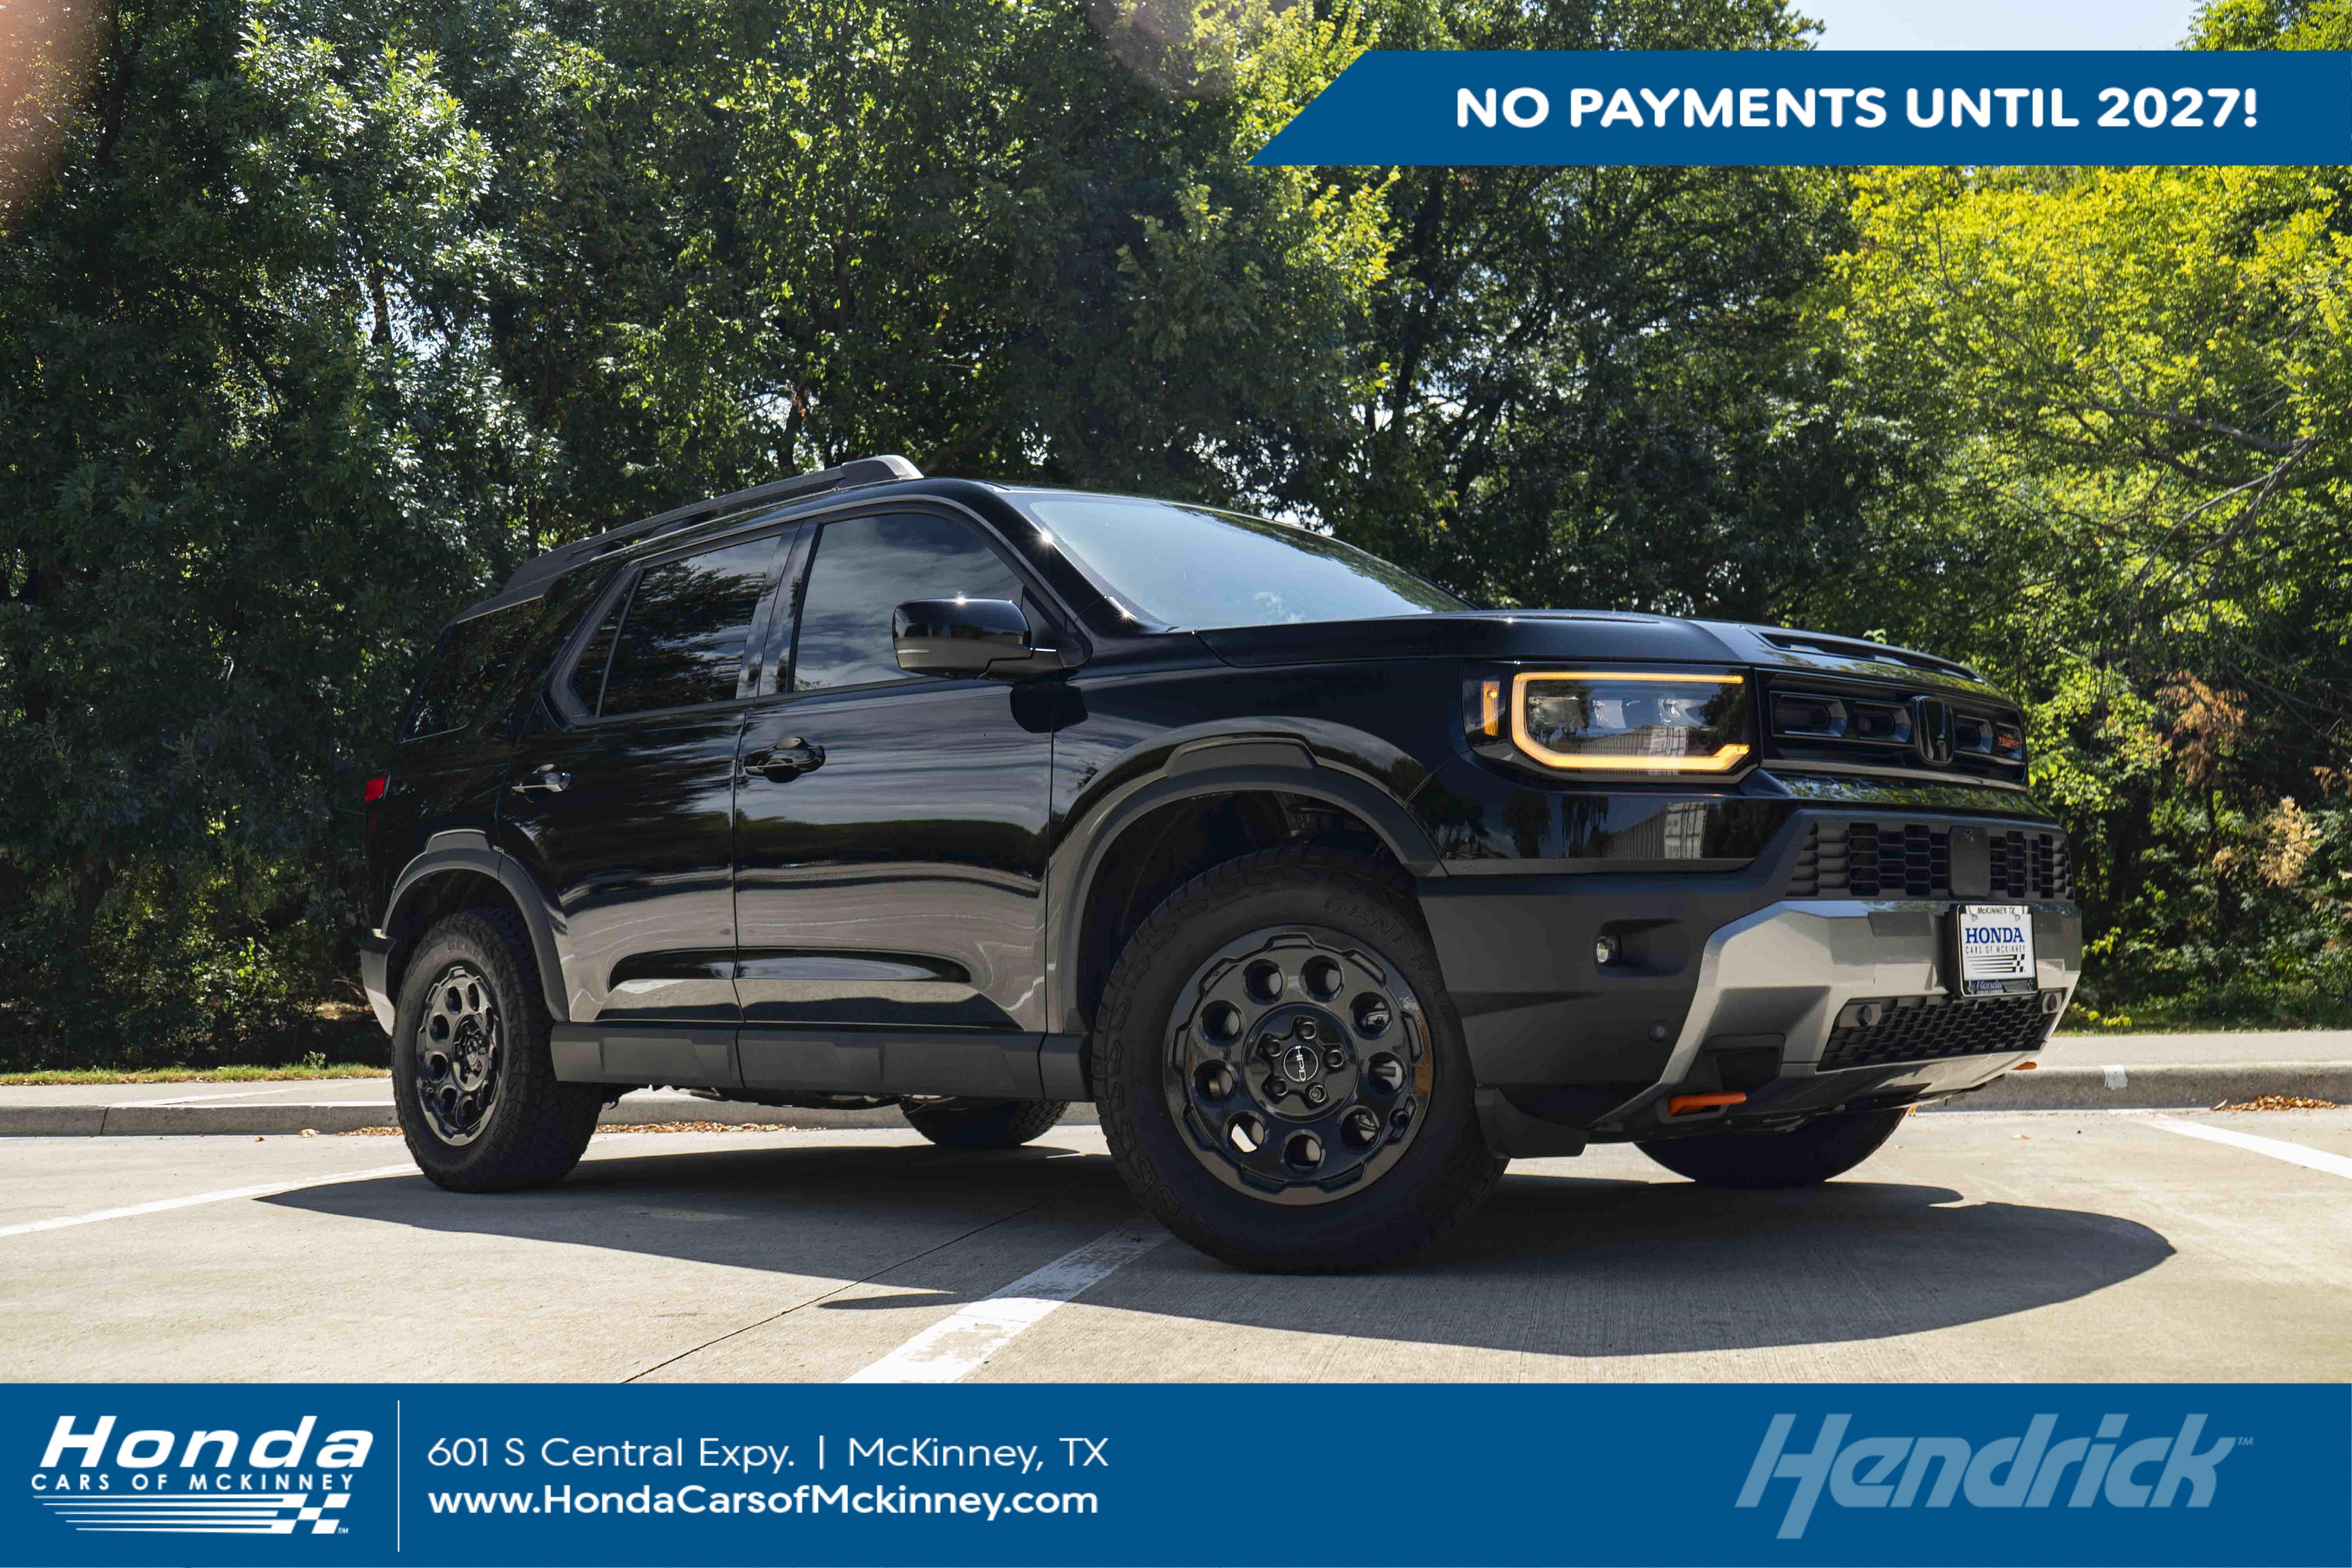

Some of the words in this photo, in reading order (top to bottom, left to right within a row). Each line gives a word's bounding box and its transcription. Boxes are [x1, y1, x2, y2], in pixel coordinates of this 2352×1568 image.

[2009, 907, 2016, 915] TX
[1965, 927, 2025, 944] HONDA
[1965, 946, 1982, 955] CARS
[1985, 945, 1993, 953] OF
[1996, 944, 2026, 953] MCKINNEY
[1295, 1045, 1306, 1081] HPD
